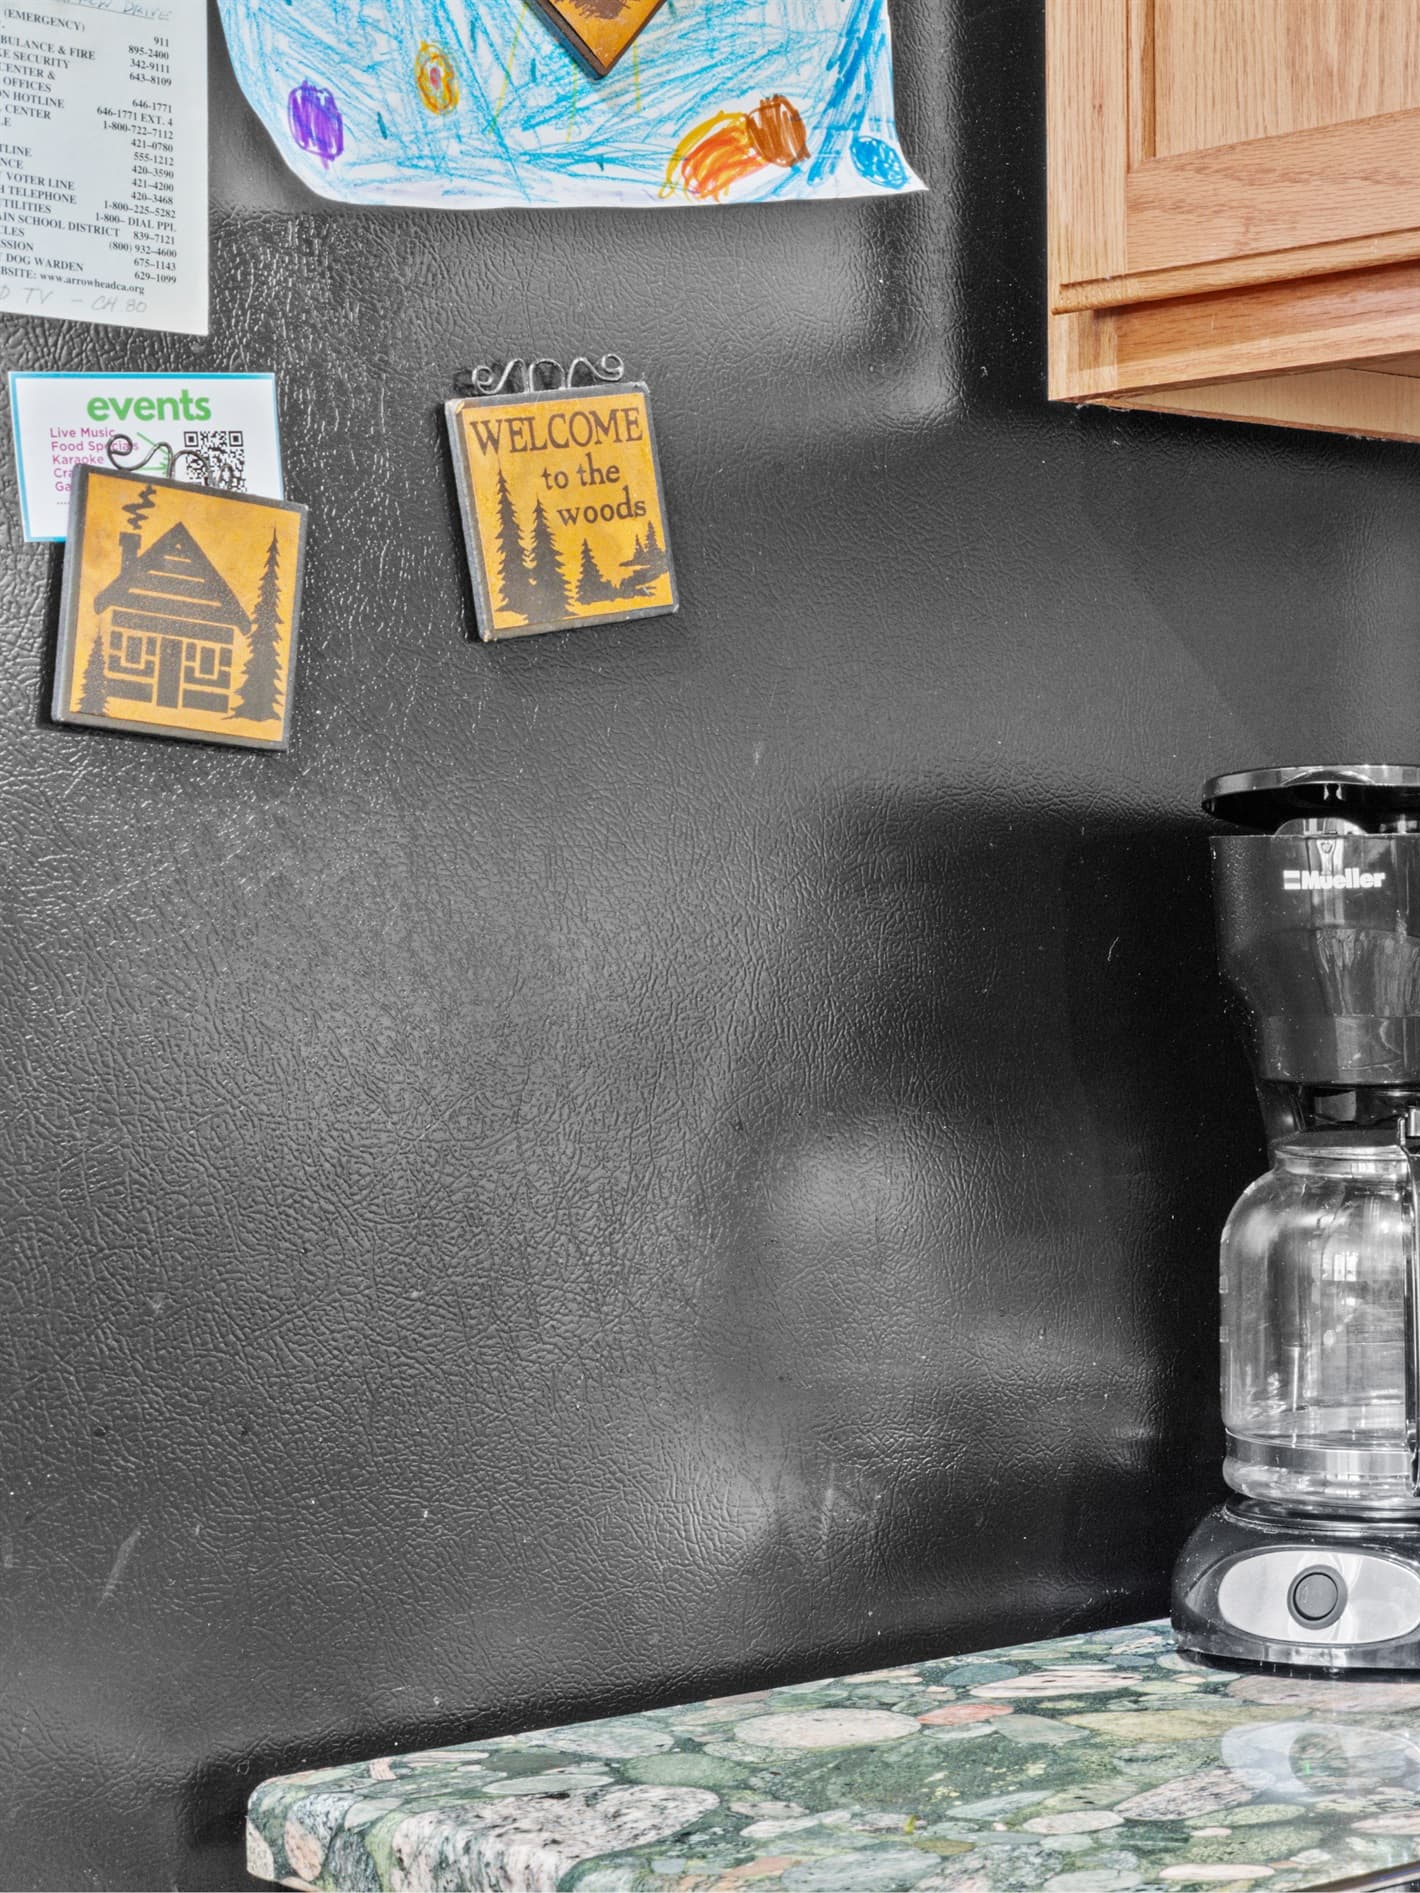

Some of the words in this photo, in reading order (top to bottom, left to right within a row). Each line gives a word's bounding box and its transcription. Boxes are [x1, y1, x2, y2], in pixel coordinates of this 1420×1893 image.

[4, 8, 85, 32] (EMERGENCY)
[0, 35, 54, 53] BULANCE
[58, 46, 66, 55] &
[70, 48, 96, 60] FIRE
[153, 36, 169, 47] 911
[13, 51, 70, 69] SECURITY
[128, 45, 169, 60] 895-2400
[130, 59, 169, 73] 342-9111
[3, 76, 52, 93] OFFICES
[47, 71, 55, 80] &
[13, 91, 64, 109] HOTLINE
[132, 99, 172, 113] 646-1771
[5, 103, 51, 120] CENTER
[96, 106, 137, 121] 646-1771
[168, 118, 173, 127] 4
[133, 152, 174, 166] 555-1212
[6, 171, 45, 186] VOTER
[48, 178, 75, 191] LINE
[8, 185, 77, 204] TELEPHONE
[18, 213, 66, 230] SCHOOL
[68, 221, 120, 238] DISTRICT
[128, 217, 154, 230] DIAL
[157, 220, 176, 233] PPL
[6, 252, 31, 266] DOG
[34, 256, 84, 272] WARDEN
[0, 265, 37, 280] BSITE:
[40, 272, 145, 295] www.arrowheadca.org
[24, 286, 55, 305] TV
[87, 388, 212, 421] events
[50, 427, 76, 438] Live
[81, 427, 116, 438] Music
[470, 407, 643, 455] WELCOME
[51, 440, 84, 452] Food
[88, 440, 139, 453] Spcias
[52, 453, 104, 465] Karaoke
[54, 467, 73, 478] Cra
[541, 467, 568, 490] to
[576, 452, 621, 487] the
[55, 480, 72, 492] Ga
[557, 485, 647, 526] woods
[1301, 867, 1386, 890] Mueller
